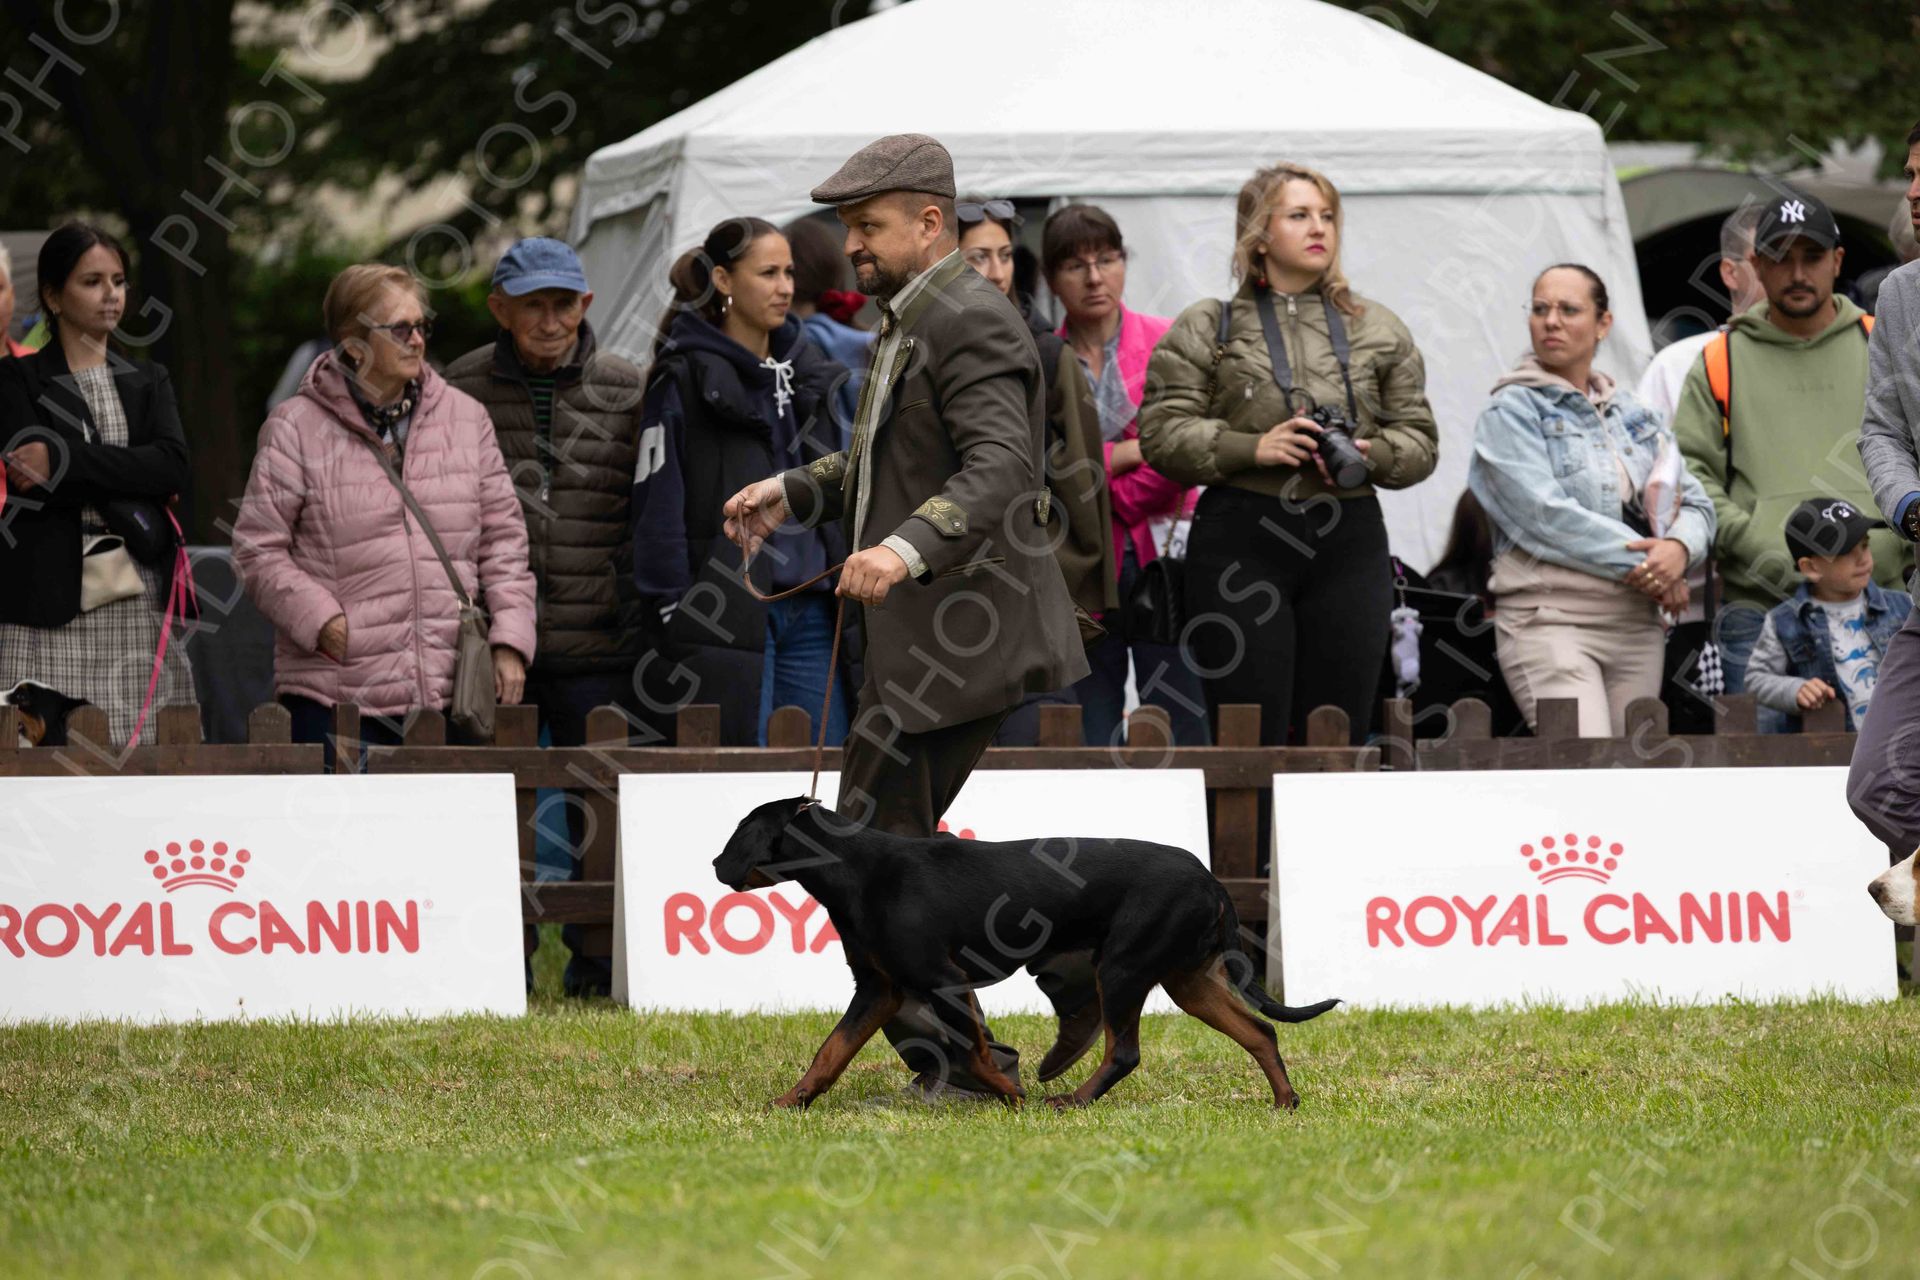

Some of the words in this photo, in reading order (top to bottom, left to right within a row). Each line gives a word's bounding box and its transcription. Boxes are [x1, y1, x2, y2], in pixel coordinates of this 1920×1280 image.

[1780, 199, 1806, 224] NY
[208, 900, 420, 955] CANIN
[663, 891, 841, 955] ROY
[1366, 893, 1568, 947] ROYAL
[1583, 891, 1791, 945] CANIN
